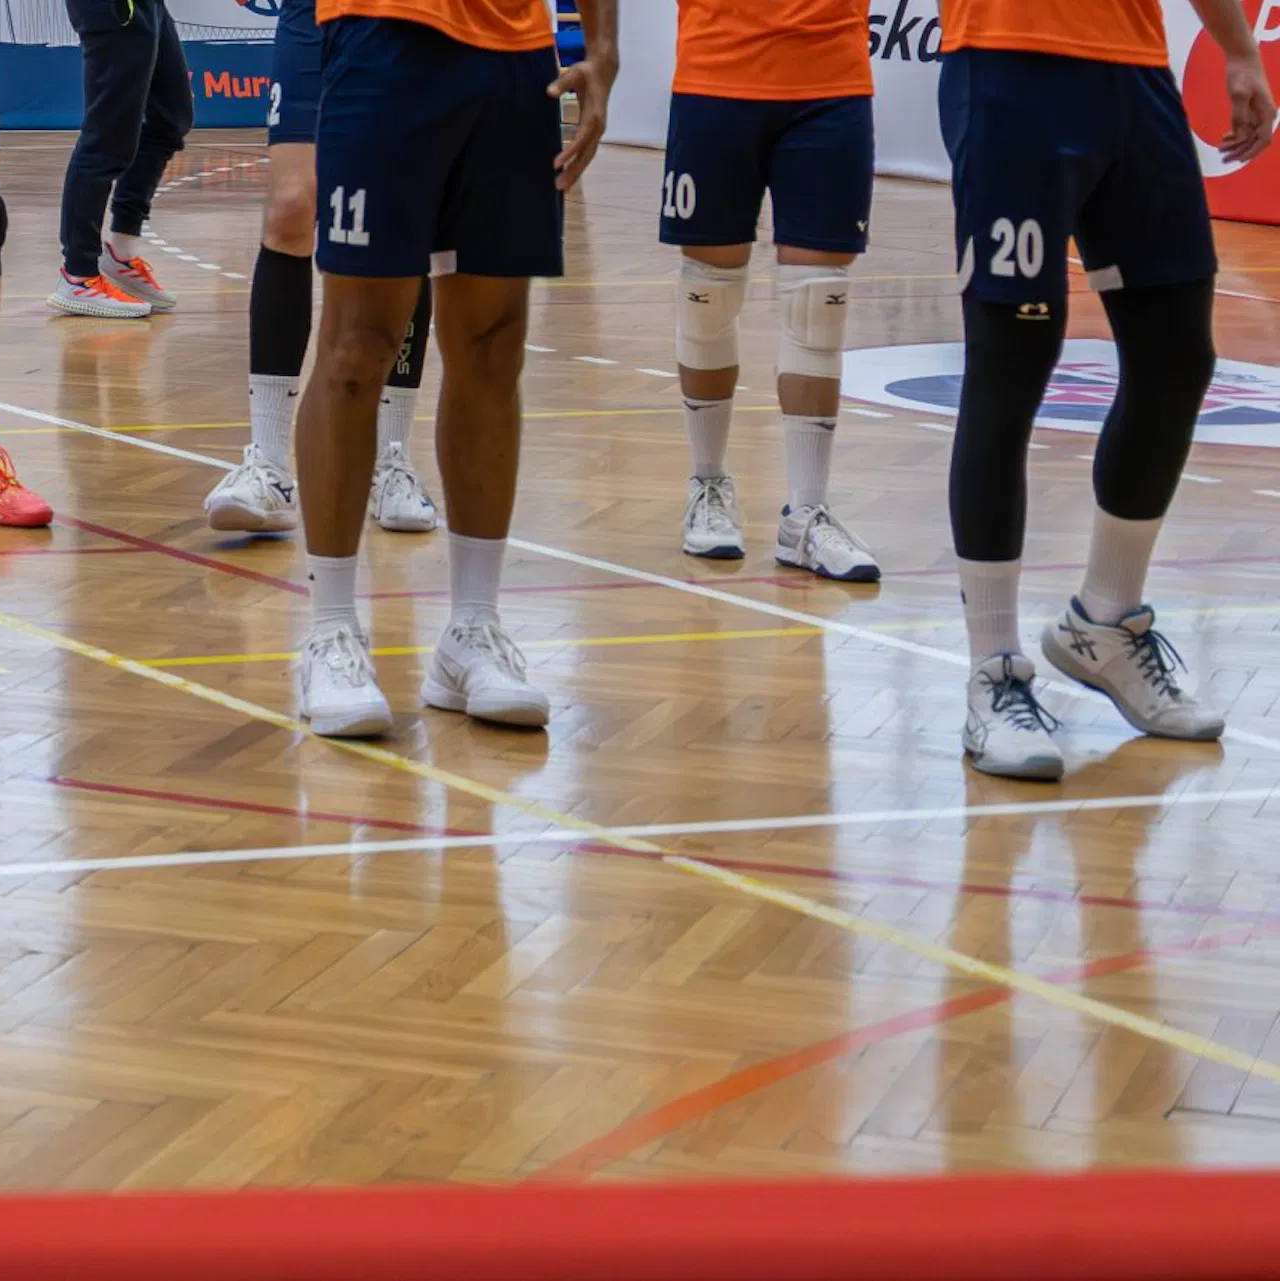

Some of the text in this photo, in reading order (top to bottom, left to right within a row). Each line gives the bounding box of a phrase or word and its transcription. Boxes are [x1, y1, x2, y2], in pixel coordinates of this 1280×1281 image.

[203, 70, 270, 99] Mur
[328, 185, 370, 246] 11
[663, 170, 696, 220] 10
[990, 216, 1044, 279] 20
